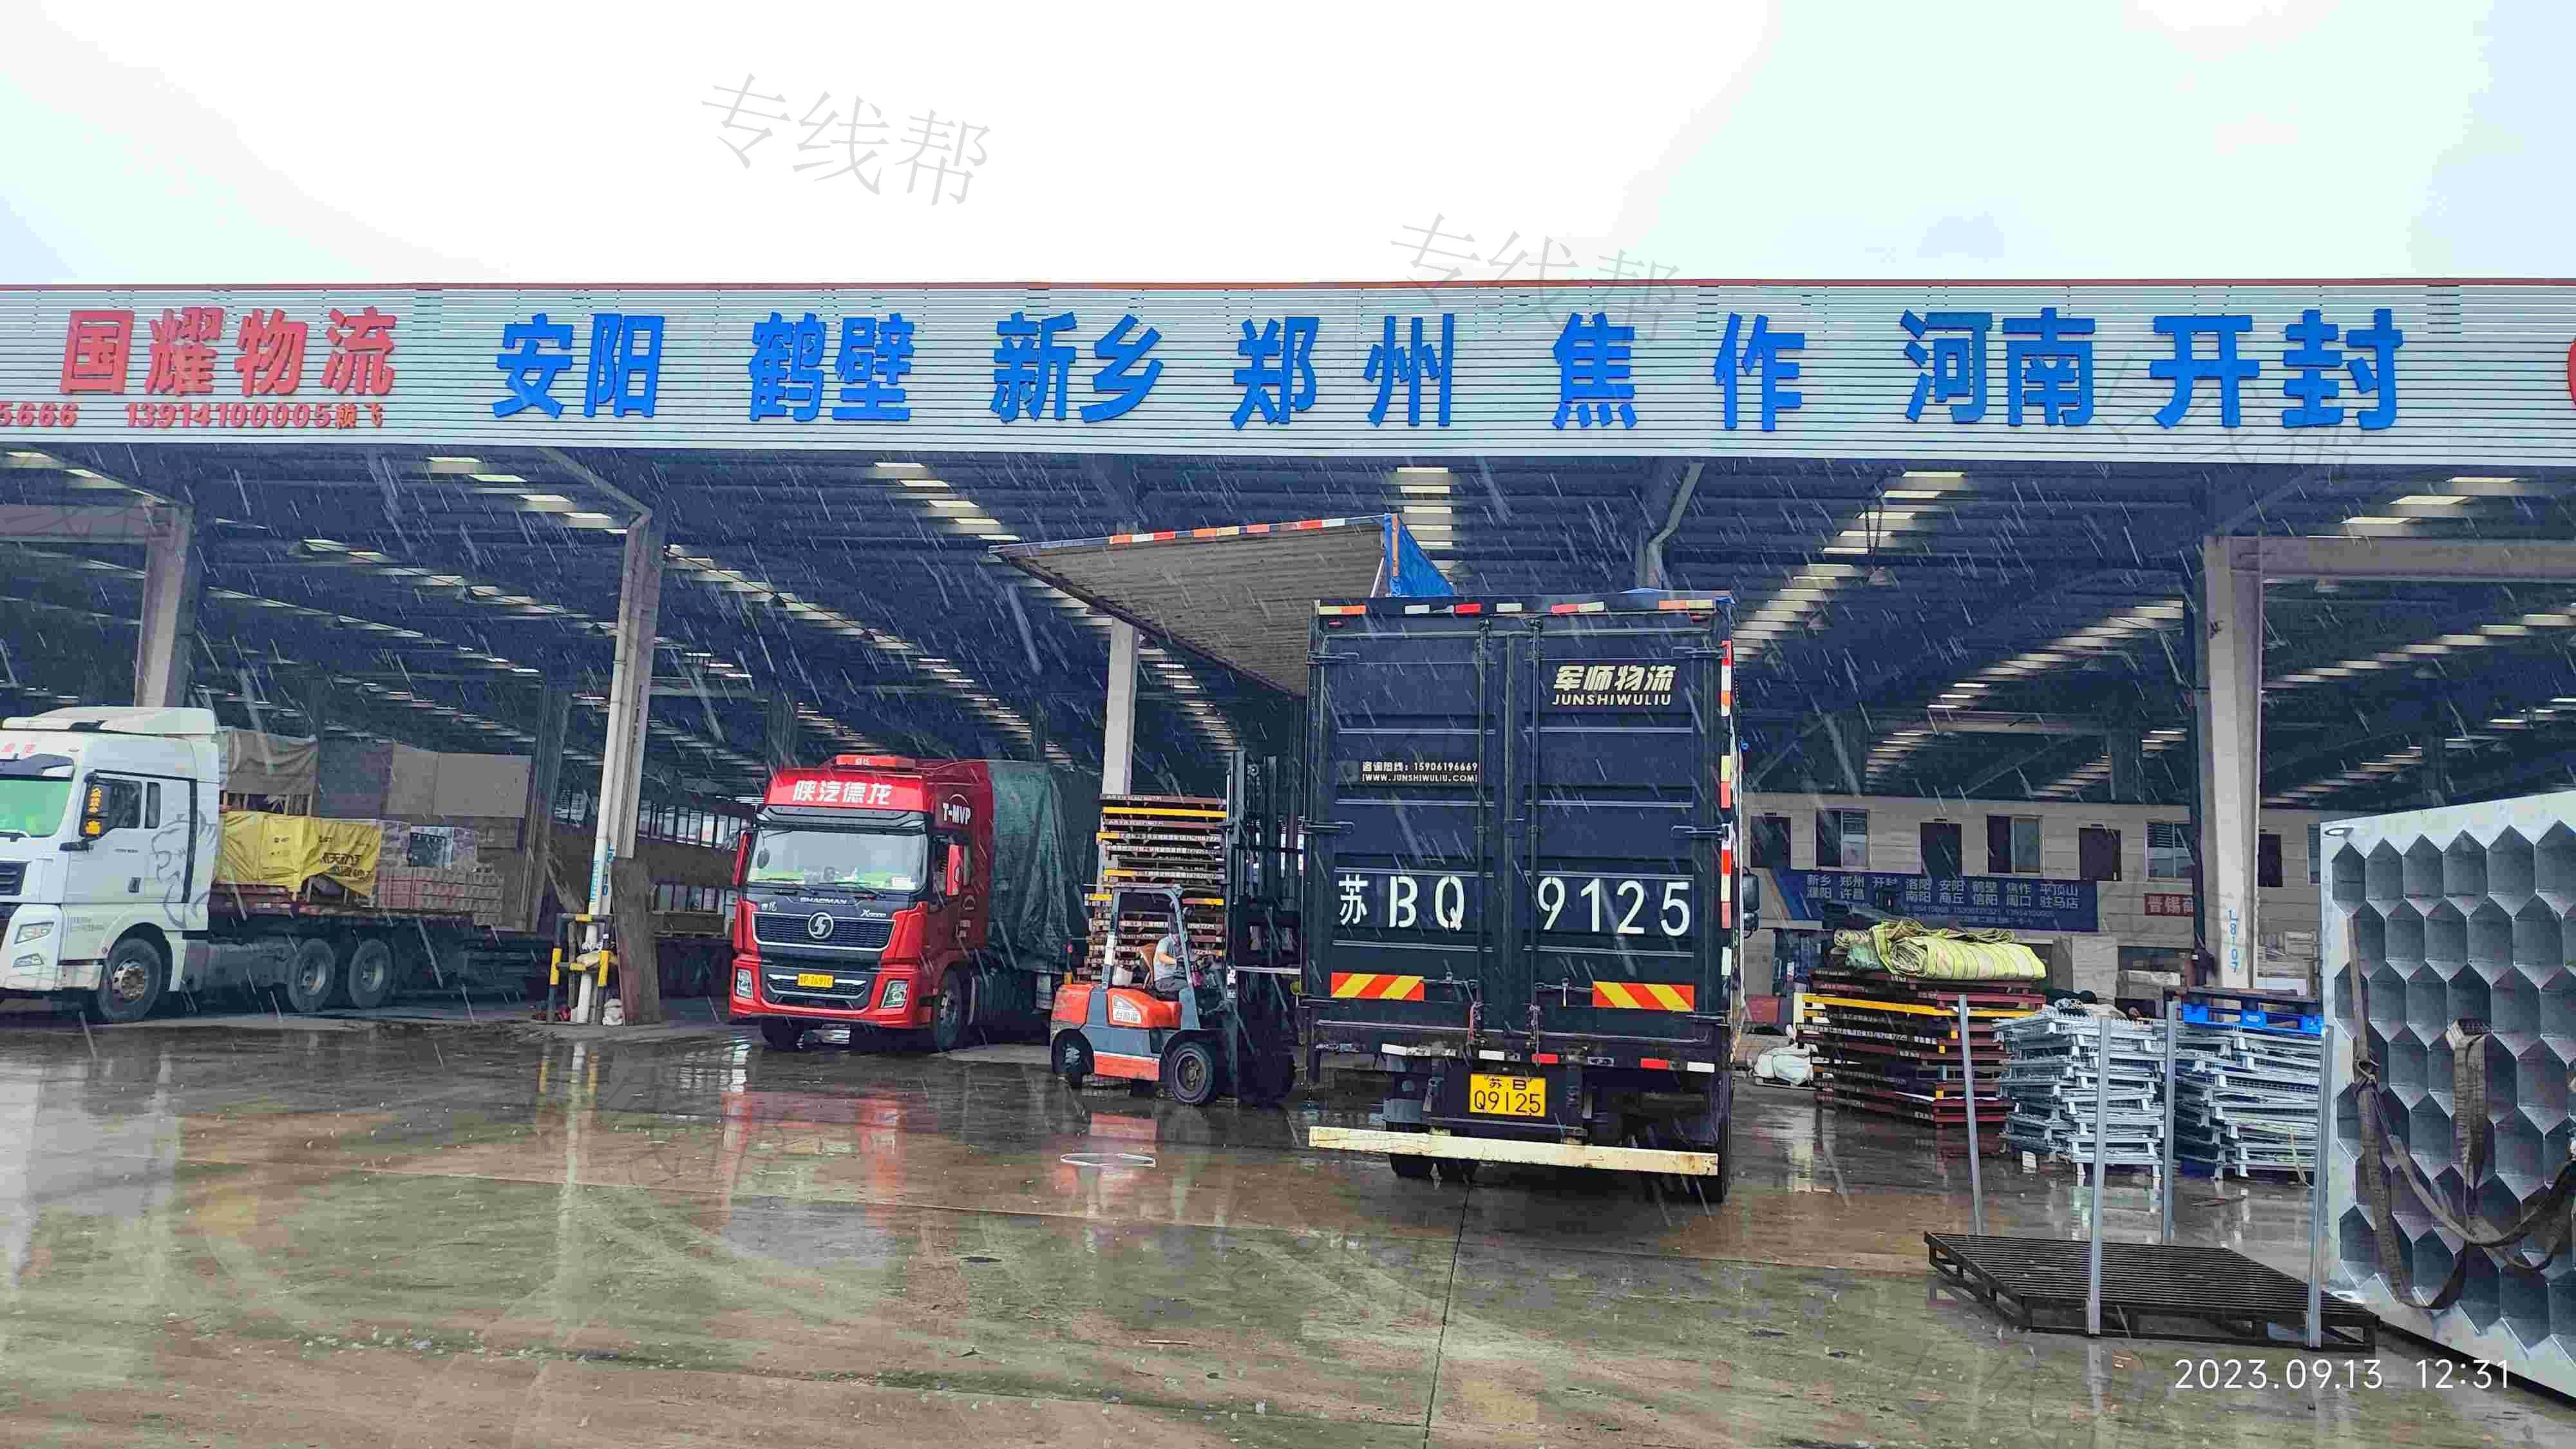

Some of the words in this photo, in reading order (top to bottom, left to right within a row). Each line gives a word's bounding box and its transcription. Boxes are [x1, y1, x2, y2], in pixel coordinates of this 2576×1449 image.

[62, 308, 395, 396] 国耀物流
[493, 313, 666, 419] 安阳
[749, 310, 916, 423] 鹤壁
[990, 311, 1163, 423] 新乡
[1231, 314, 1454, 430] 郑州
[1551, 313, 1806, 433] 焦作
[1900, 309, 2096, 426] 河南
[2149, 310, 2406, 430] 开封
[1553, 665, 1676, 691] 军师物流
[1552, 693, 1672, 706] JUNSHIWULIU
[793, 780, 893, 805] 陕汽德龙
[1806, 875, 1831, 886] 新乡
[1840, 875, 1865, 887] 郑州
[1938, 880, 1965, 892] 安阳
[2040, 884, 2078, 897] 平顶山
[1338, 874, 1465, 931] 苏BQ
[1537, 876, 1690, 936] 9125
[1473, 1092, 1541, 1114] Q9125
